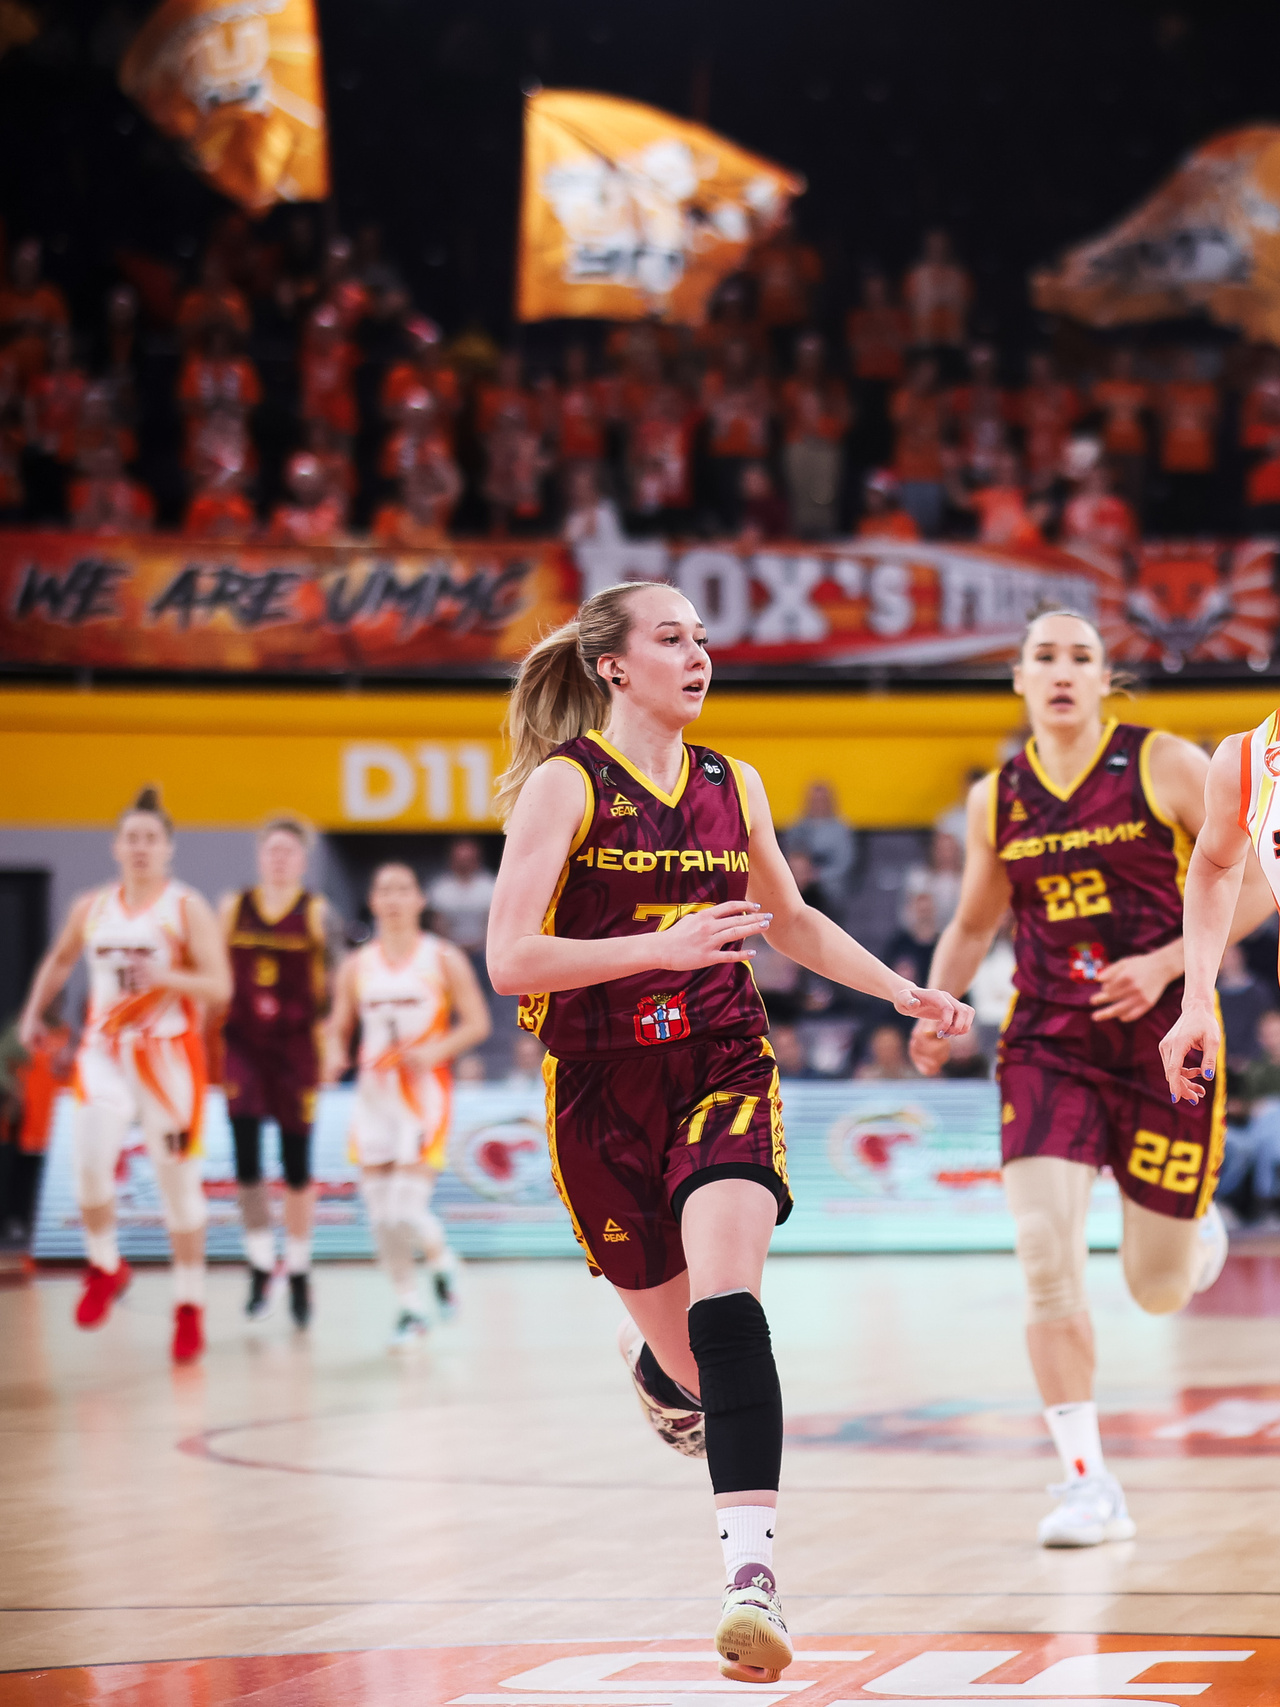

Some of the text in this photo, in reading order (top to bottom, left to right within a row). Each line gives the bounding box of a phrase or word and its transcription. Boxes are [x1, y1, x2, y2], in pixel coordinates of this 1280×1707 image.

[14, 560, 124, 626] WE
[146, 564, 300, 630] ARE
[610, 806, 639, 817] PEAK
[1036, 868, 1112, 922] 22
[678, 1091, 761, 1146] 77
[1127, 1129, 1203, 1194] 22
[603, 1232, 630, 1243] PEAK
